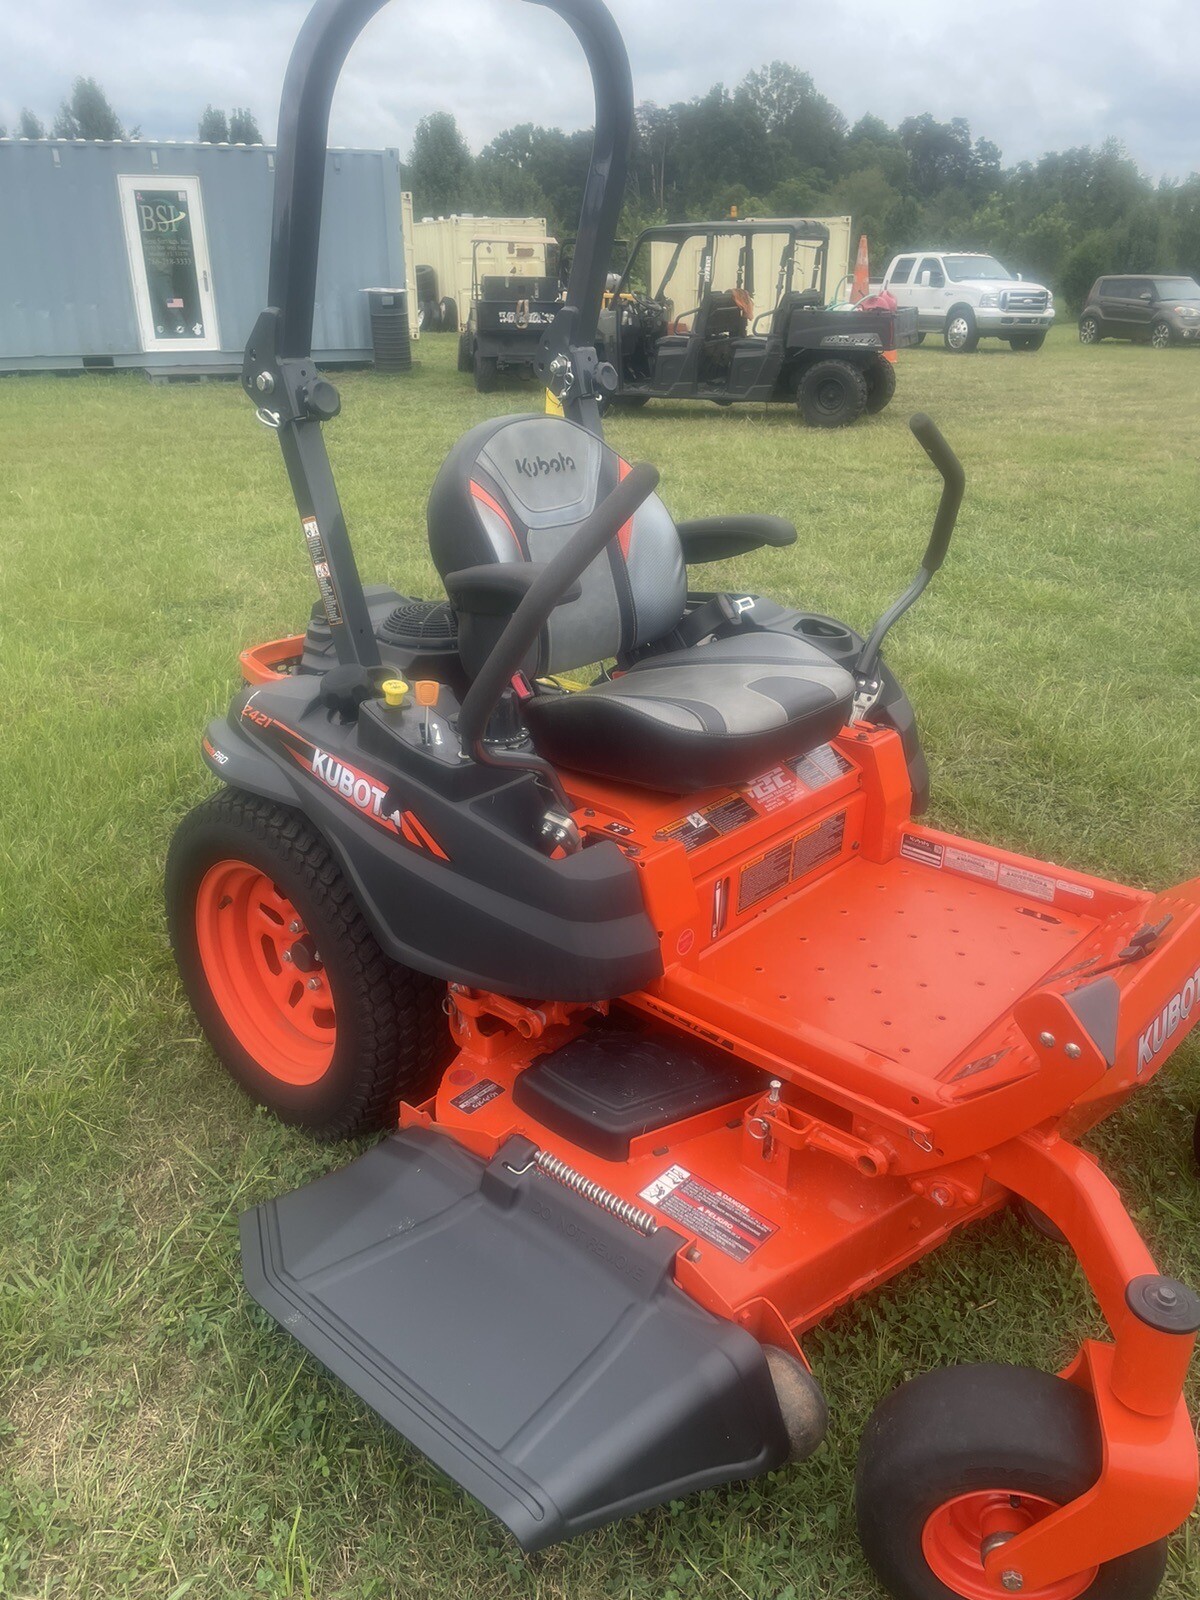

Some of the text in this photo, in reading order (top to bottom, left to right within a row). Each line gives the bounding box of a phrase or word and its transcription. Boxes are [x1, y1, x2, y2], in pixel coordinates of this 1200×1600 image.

[139, 204, 178, 232] BSI
[515, 452, 576, 477] Kubota
[212, 751, 229, 764] PRO
[722, 1194, 750, 1213] DANGER
[704, 1209, 734, 1229] PELIGRO
